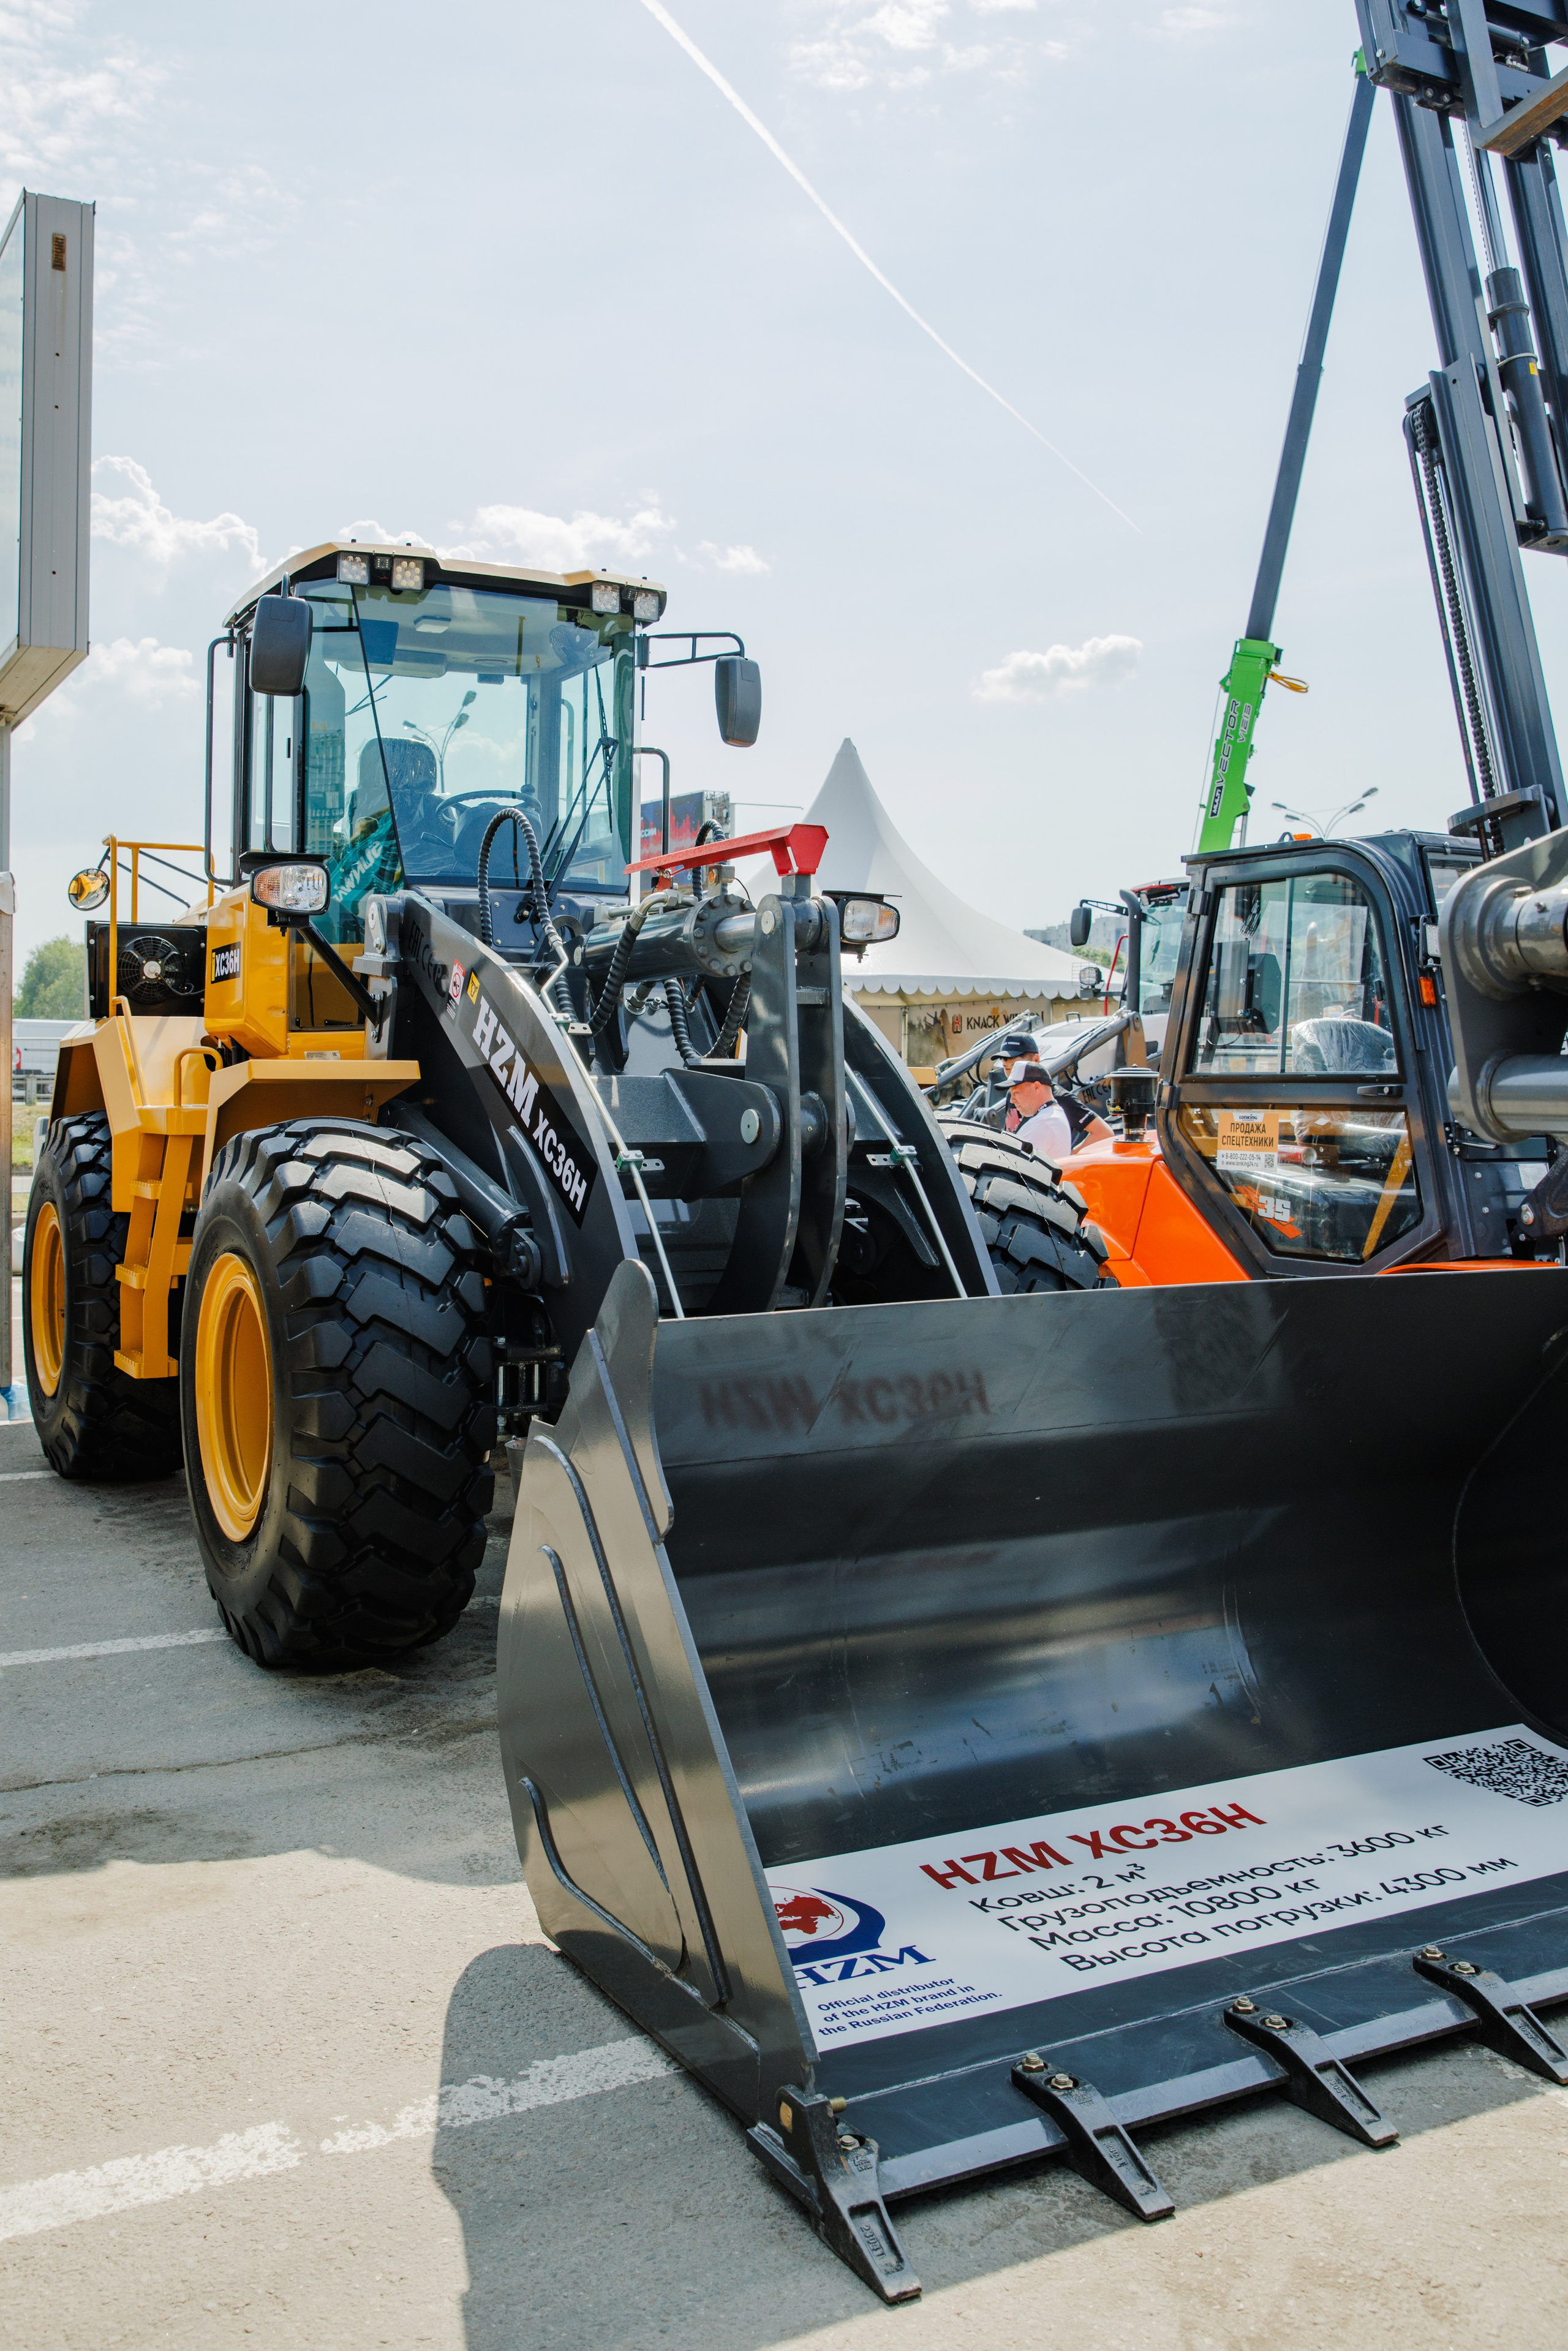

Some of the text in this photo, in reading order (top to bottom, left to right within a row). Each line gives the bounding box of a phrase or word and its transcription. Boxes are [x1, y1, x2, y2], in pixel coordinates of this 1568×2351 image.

[1212, 700, 1239, 815] MULTI VECTOR
[215, 948, 240, 978] XC36H
[967, 1014, 1000, 1030] KNACK
[472, 995, 587, 1212] HZM XC36H
[1222, 1135, 1274, 1147] СПЕЦТЕХНИКИ
[1231, 1123, 1266, 1134] ПРОДАЖА
[1257, 1194, 1291, 1223] 35
[919, 1803, 1267, 1890] HZM XC36H
[968, 1883, 1085, 1913] Ковш:
[1082, 1874, 1114, 1890] 2
[997, 1825, 1450, 1931] Грузоподъемность: 3600 кг
[1028, 1879, 1321, 1951] Масса: 10800 кг
[1059, 1858, 1519, 1971] Высота погрузки: 4300 мм
[794, 1945, 937, 1990] HZM
[818, 1977, 956, 2012] Official distributor
[818, 1991, 1003, 2036] the Russian Federation.
[823, 1984, 976, 2023] of the HZM brand in
